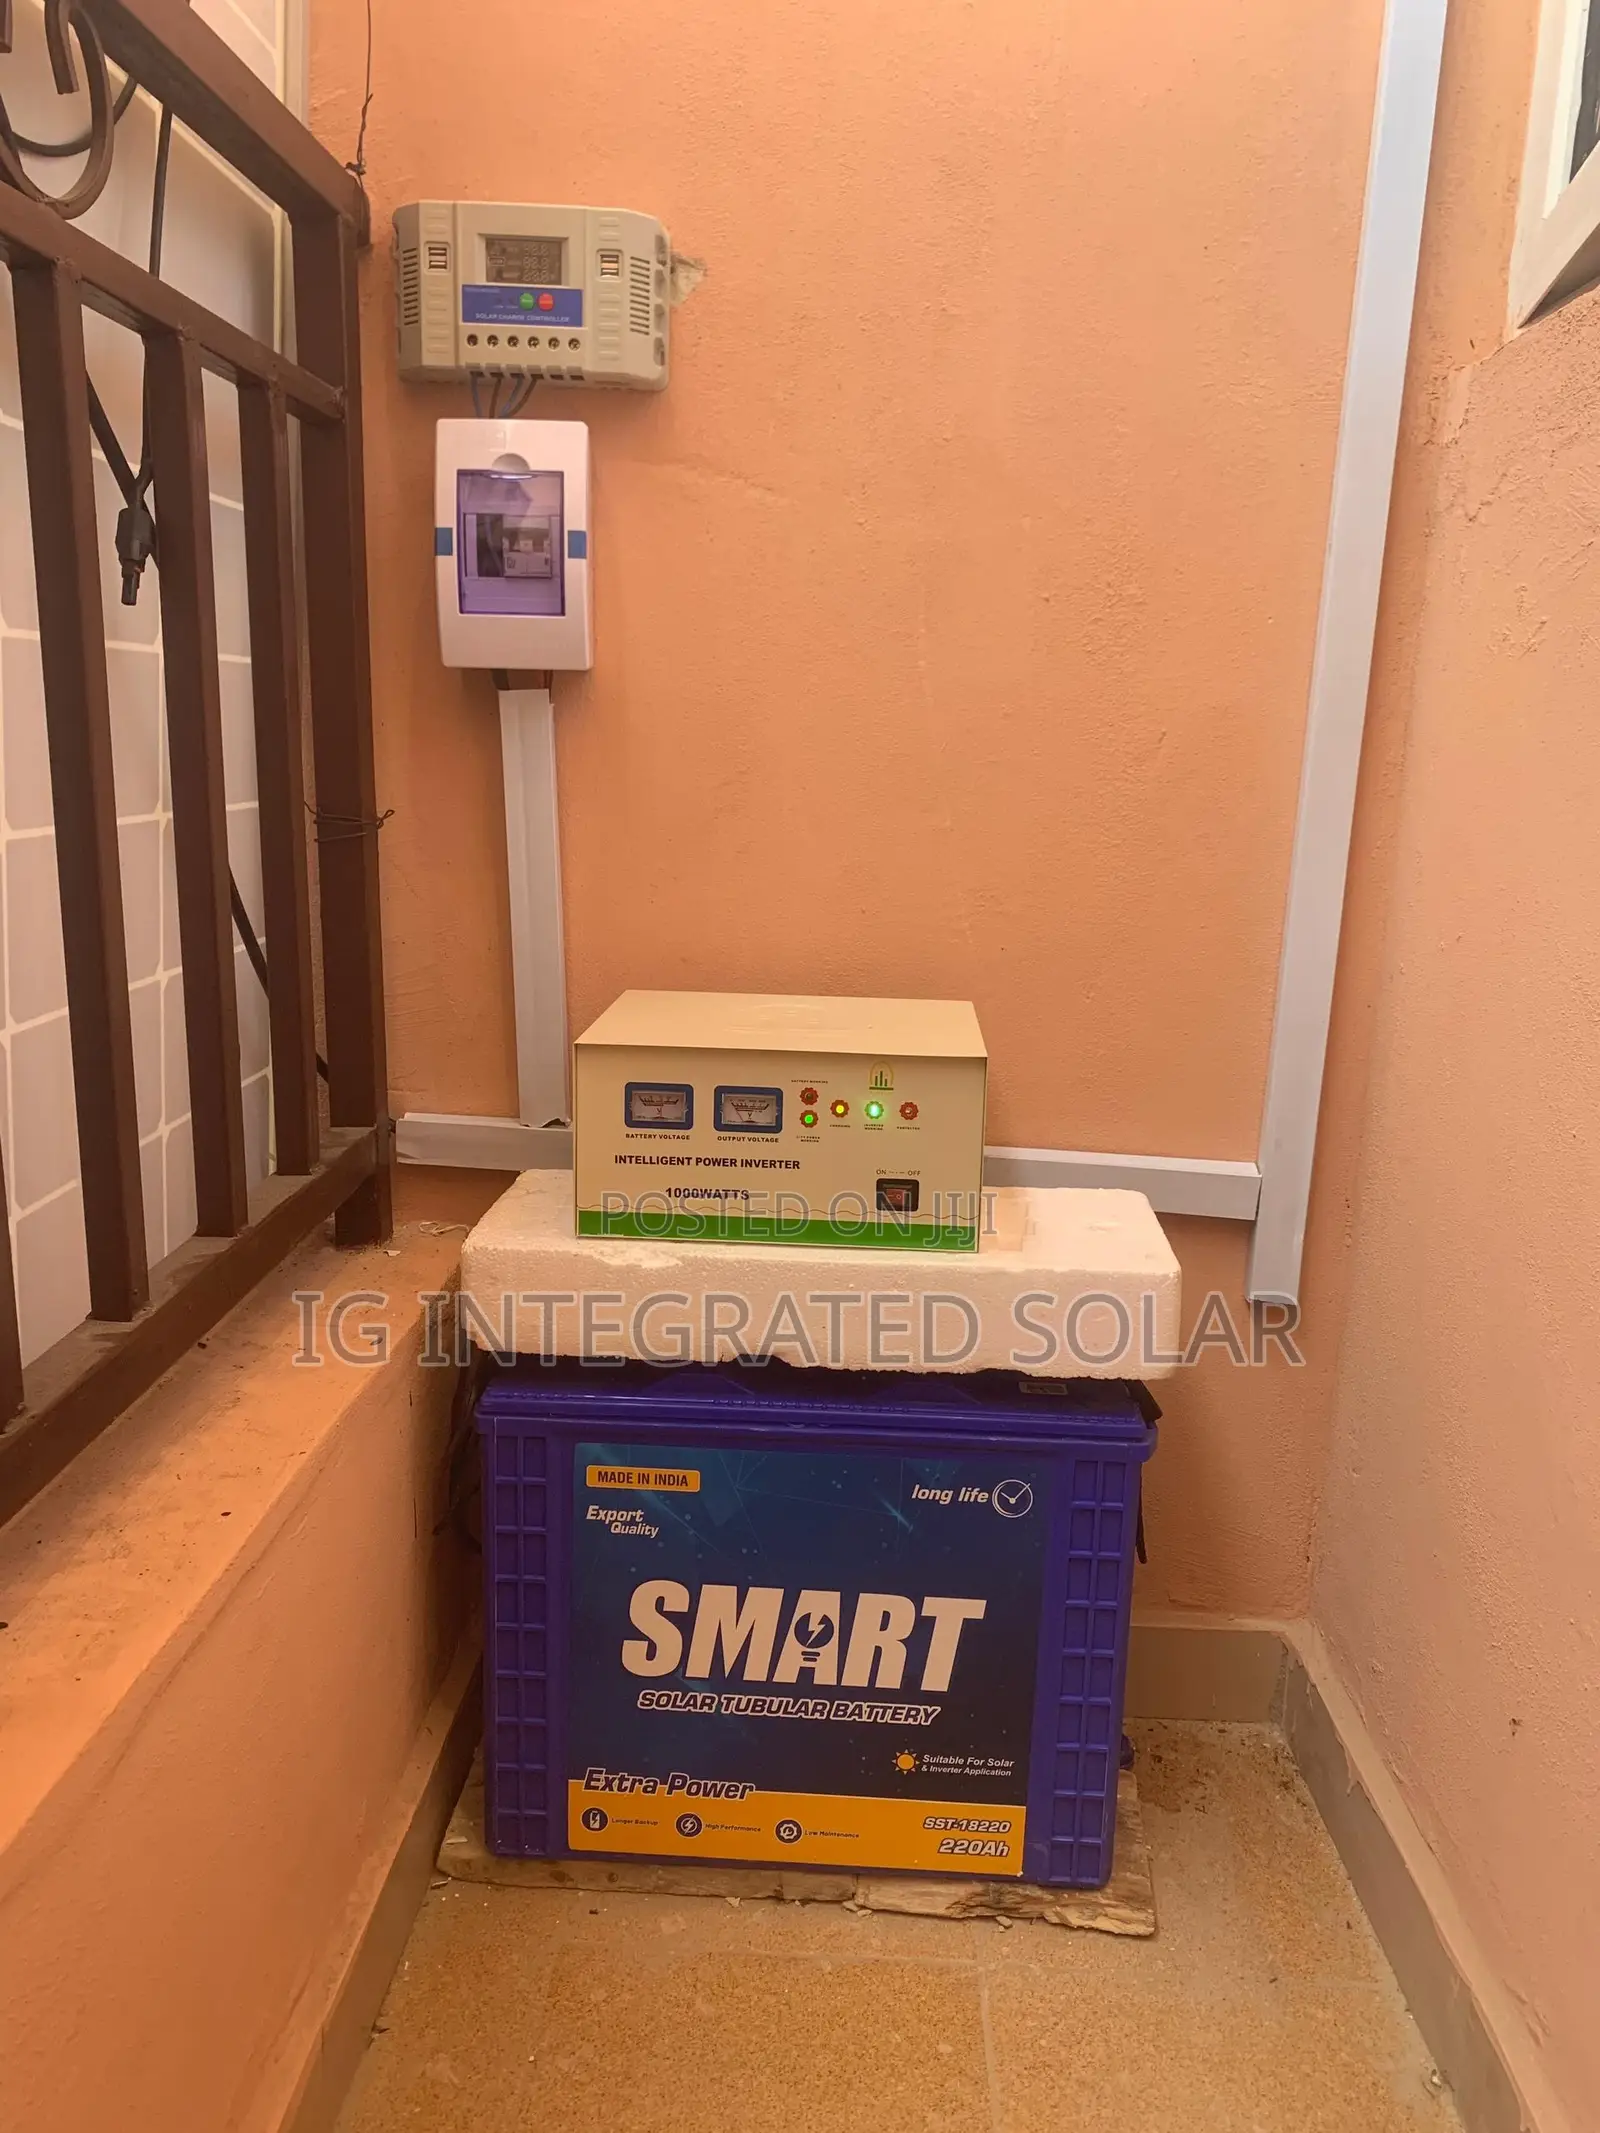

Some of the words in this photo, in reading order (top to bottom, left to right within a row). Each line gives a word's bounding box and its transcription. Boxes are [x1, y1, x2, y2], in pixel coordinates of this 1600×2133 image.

[614, 1154, 693, 1167] INTELLIGENT
[695, 1156, 738, 1168] POWER
[740, 1158, 801, 1170] INVERTER
[665, 1186, 750, 1201] 1000WATTS
[597, 1470, 634, 1485] MADE
[637, 1472, 651, 1485] IN
[654, 1474, 688, 1487] INDIA
[911, 1484, 954, 1505] long
[957, 1487, 989, 1503] life
[586, 1505, 644, 1524] Export
[610, 1521, 660, 1539] Quality
[621, 1579, 988, 1692] SMART
[637, 1690, 717, 1712] SOLAR
[720, 1695, 829, 1721] TUBULAR
[830, 1700, 941, 1726] BATTERY
[922, 1754, 965, 1766] Suitable
[967, 1757, 985, 1767] For
[987, 1758, 1015, 1768] Solar
[921, 1764, 928, 1772] &
[929, 1765, 963, 1774] Inverter
[963, 1767, 1012, 1777] Application
[583, 1767, 660, 1795] Extra
[666, 1772, 755, 1801] Power
[720, 1824, 762, 1832] Performance
[923, 1816, 1013, 1834] SST-18220
[937, 1837, 1011, 1858] 220Ah
